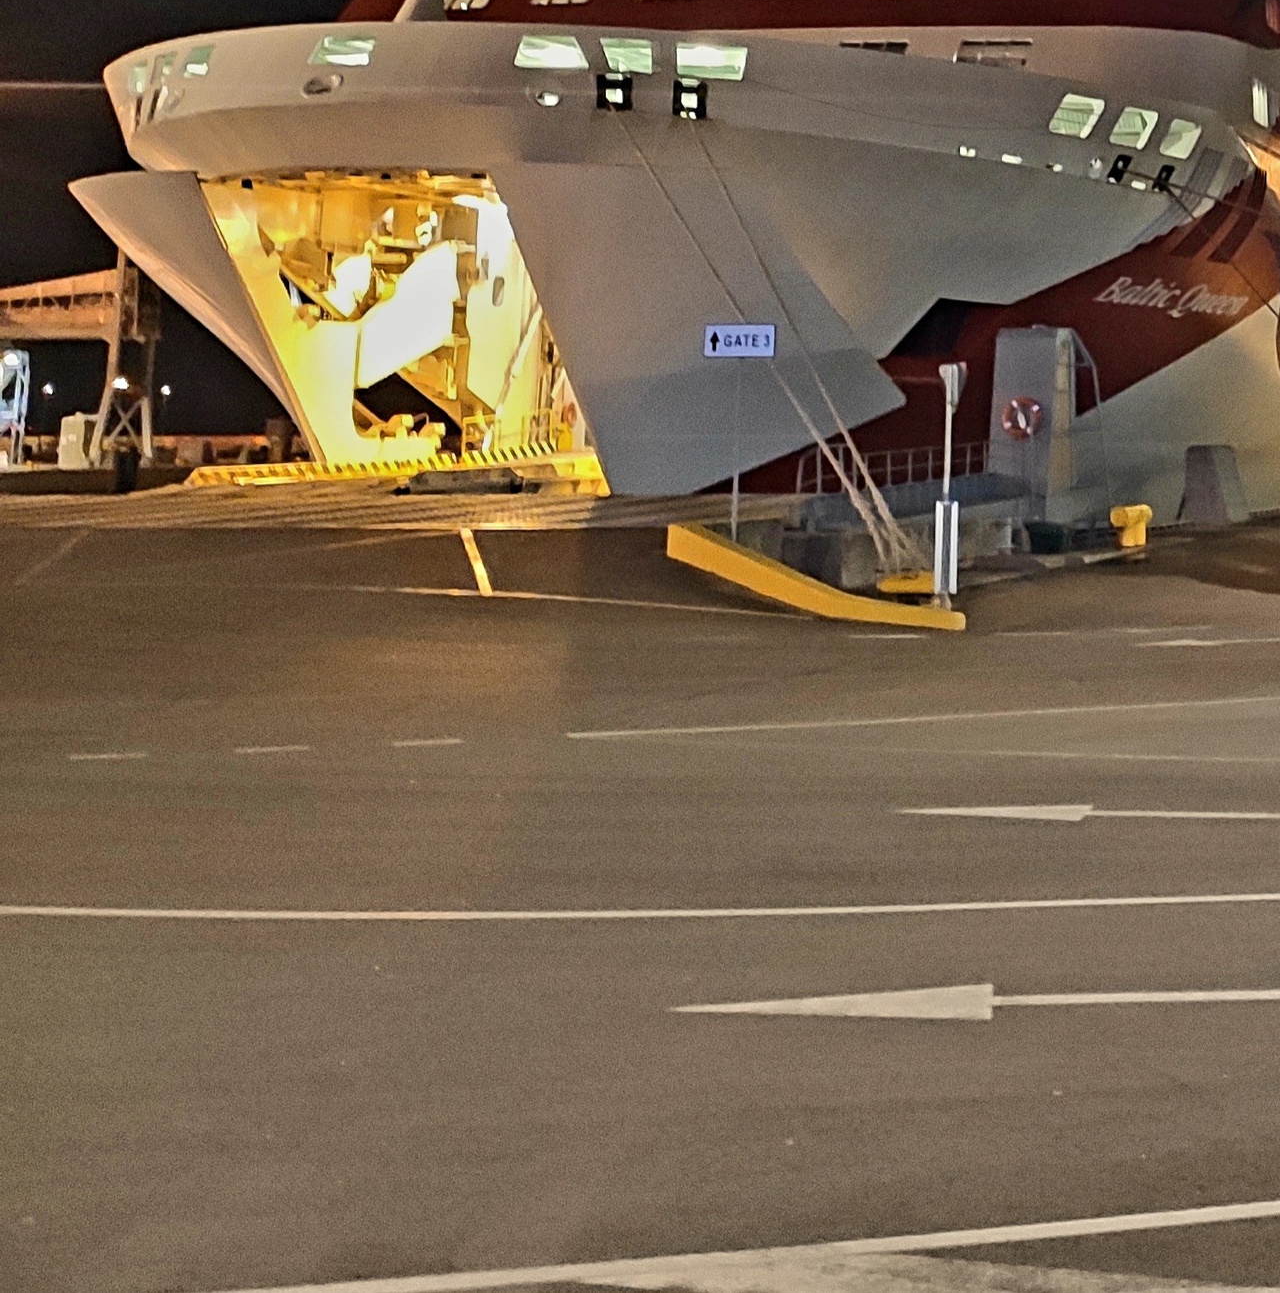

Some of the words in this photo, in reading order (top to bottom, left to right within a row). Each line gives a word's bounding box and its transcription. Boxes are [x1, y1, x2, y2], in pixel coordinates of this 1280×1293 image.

[1093, 275, 1182, 309] Baltic
[723, 333, 760, 348] GATE
[763, 333, 771, 348] 3
